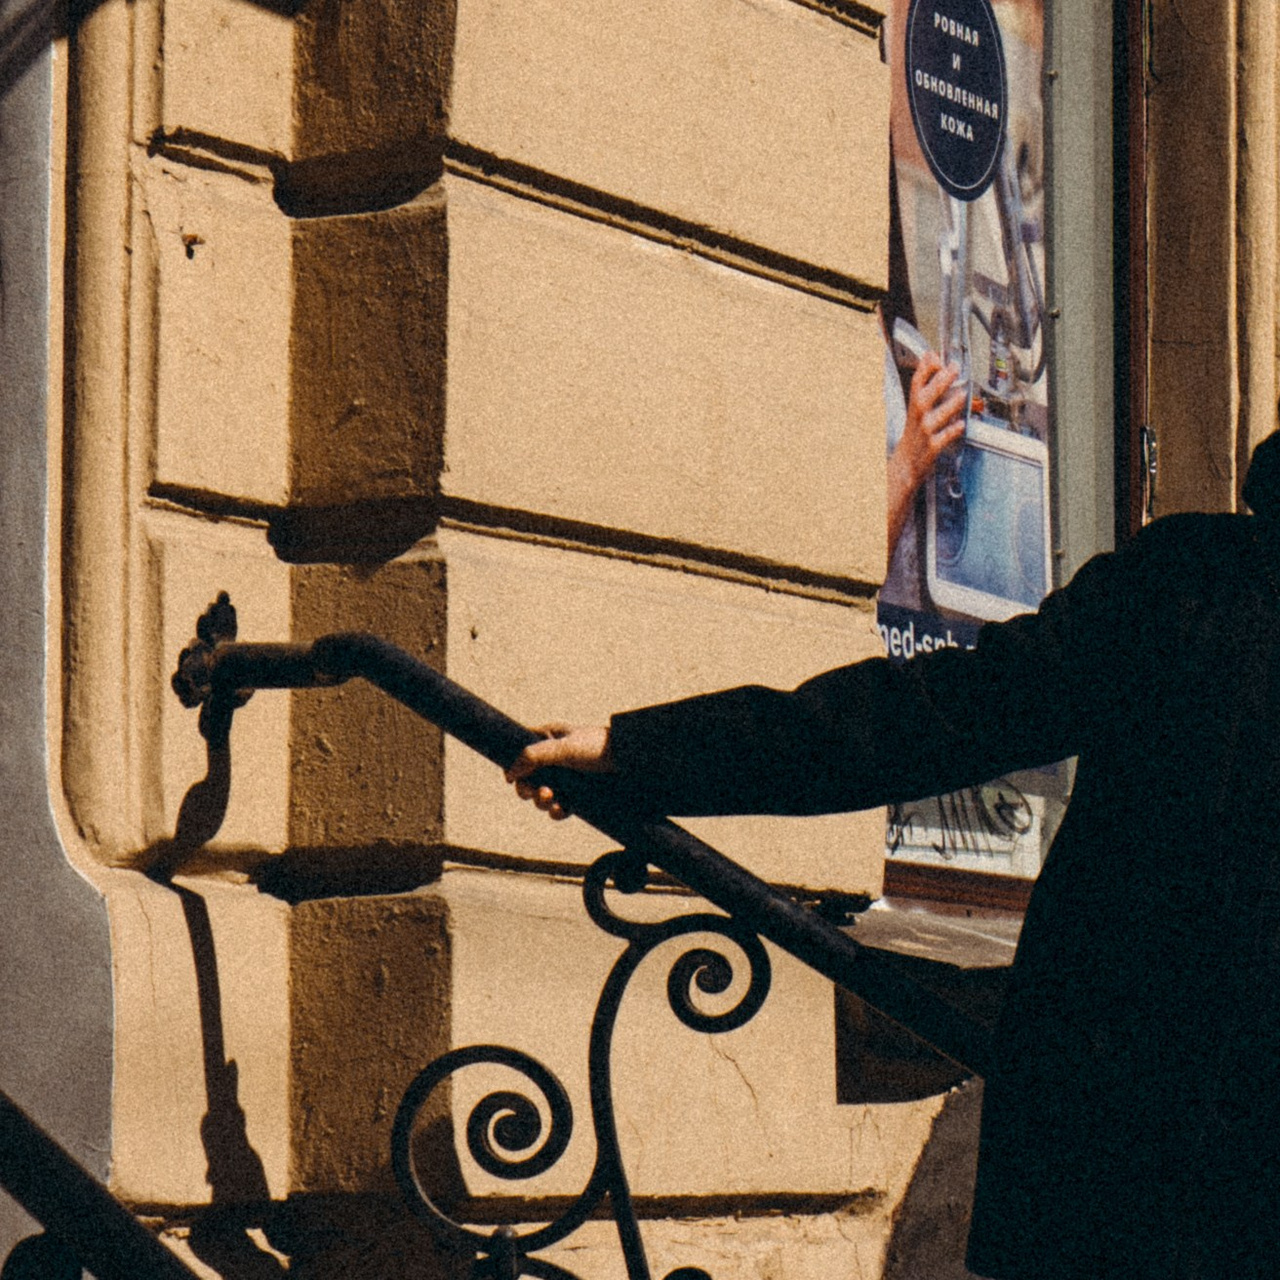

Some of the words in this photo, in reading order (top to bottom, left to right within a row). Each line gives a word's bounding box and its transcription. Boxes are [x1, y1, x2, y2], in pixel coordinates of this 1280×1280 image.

[934, 12, 980, 47] РОВНАЯ
[952, 53, 961, 71] И
[915, 69, 999, 120] ОБНОВЛЕННАЯ
[940, 112, 974, 142] КОЖА
